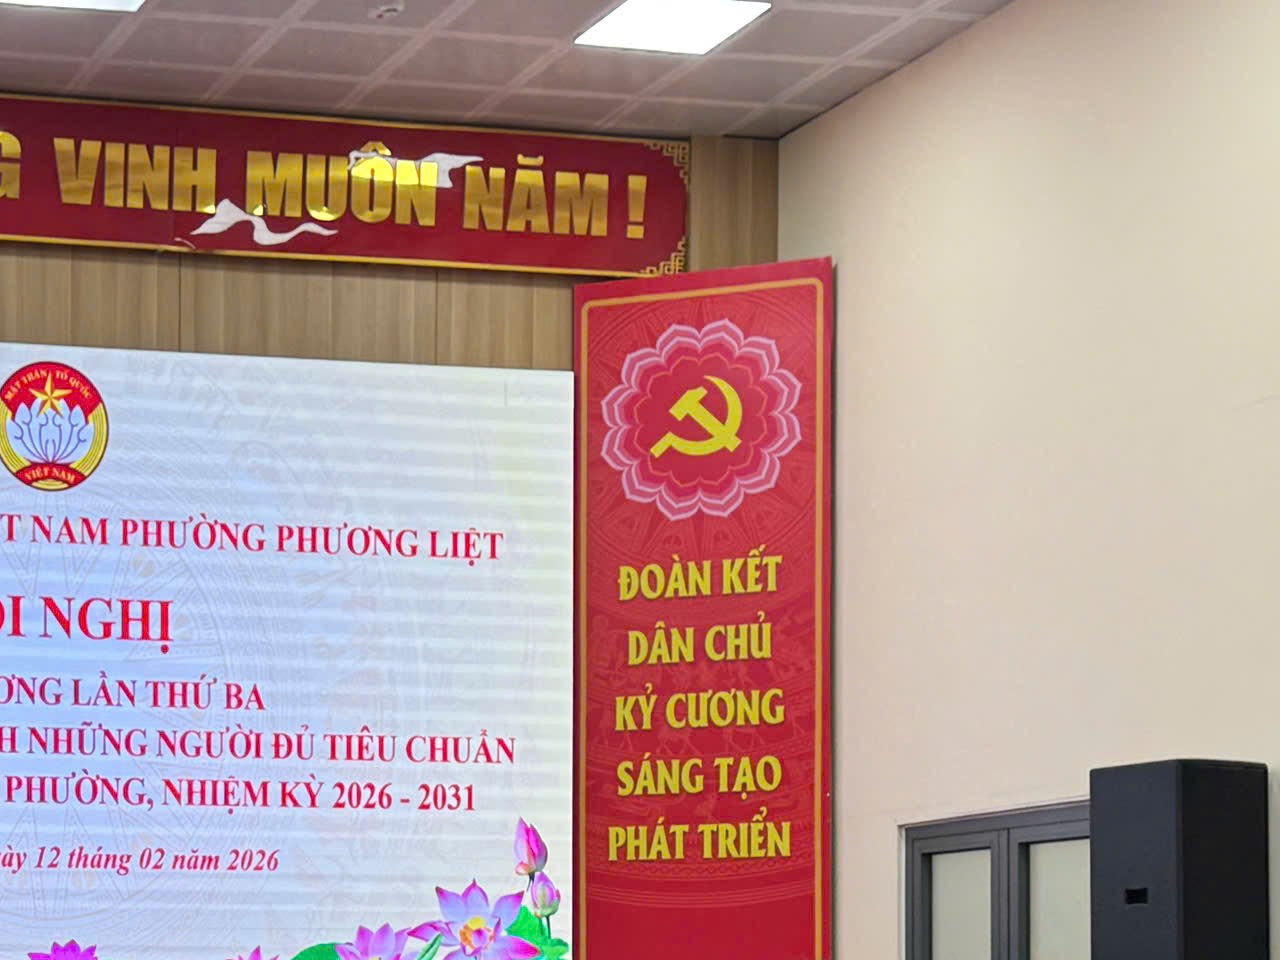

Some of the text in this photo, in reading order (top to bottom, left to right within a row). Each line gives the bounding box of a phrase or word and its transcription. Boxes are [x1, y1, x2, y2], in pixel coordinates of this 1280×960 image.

[52, 137, 216, 214] VINH
[246, 141, 438, 226] MUÔN
[463, 153, 609, 237] NĂM
[30, 515, 109, 545] NAM
[120, 513, 266, 552] PHƯỜNG
[276, 521, 418, 556] PHƯƠNG
[428, 527, 504, 567] LIỆT
[618, 544, 783, 601] ĐOÀN KẾT
[39, 596, 174, 653] NGHỊ
[628, 610, 771, 666] DÂN CHỦ
[71, 672, 137, 709] LẦN
[145, 673, 217, 710] THỨ
[224, 683, 265, 711] BA
[615, 683, 785, 731] KỶ CƯƠNG
[27, 721, 148, 758] NHỮNG
[156, 724, 263, 760] NGƯỜI
[271, 724, 315, 761] ĐỦ
[323, 726, 396, 762] TIÊU
[405, 727, 516, 765] CHUẨN
[5, 769, 154, 811] PHƯỜNG,
[161, 774, 274, 815] NHIỆM
[280, 773, 324, 809] KỲ
[332, 782, 392, 810] 2026
[418, 783, 475, 811] 2031
[617, 752, 782, 800] SÁNG TẠO
[608, 806, 791, 861] PHÁT TRIỂN
[34, 846, 60, 869] 12
[67, 846, 131, 875] tháng
[138, 847, 164, 870] 02
[171, 849, 221, 871] năm
[228, 848, 279, 871] 2026
